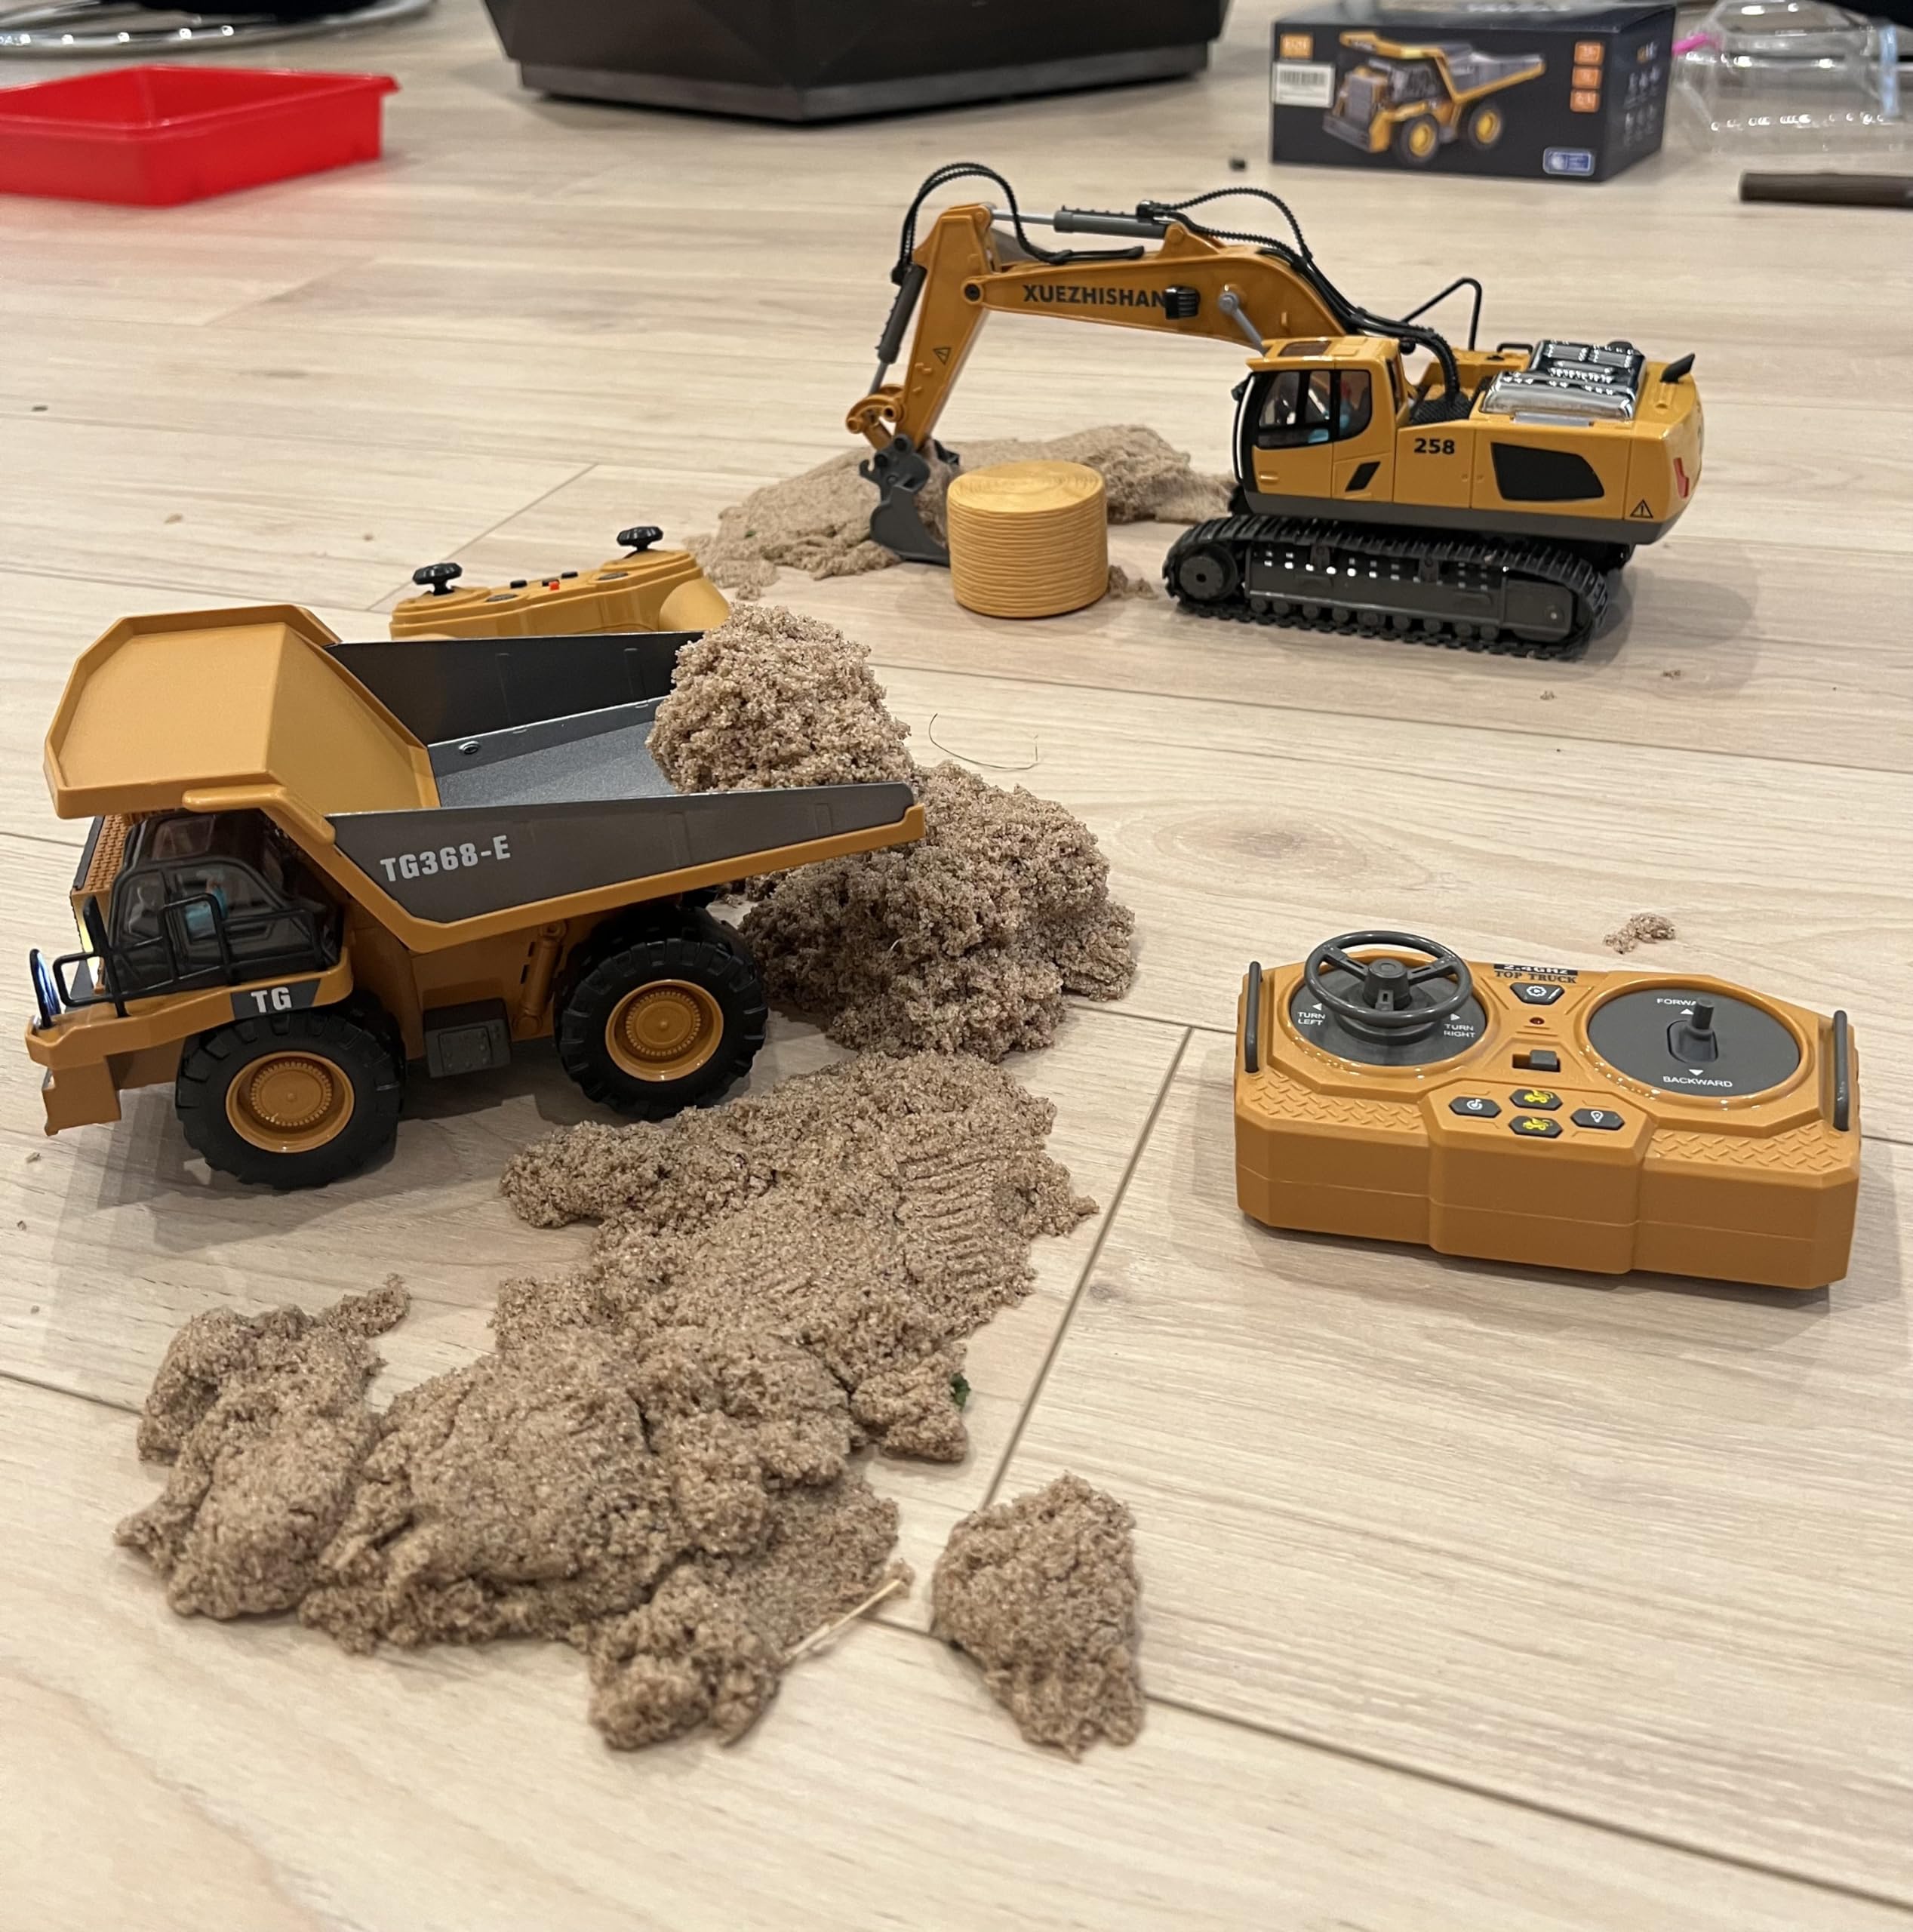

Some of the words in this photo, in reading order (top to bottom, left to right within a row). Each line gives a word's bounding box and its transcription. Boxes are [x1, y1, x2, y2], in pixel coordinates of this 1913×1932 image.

[1413, 438, 1455, 455] 258
[380, 835, 511, 881] TG368-E
[1494, 970, 1522, 980] TOP
[1528, 973, 1576, 984] TRUCK
[251, 986, 292, 1013] TG
[1298, 1011, 1326, 1020] TURN
[1662, 1075, 1733, 1088] BACKWARD
